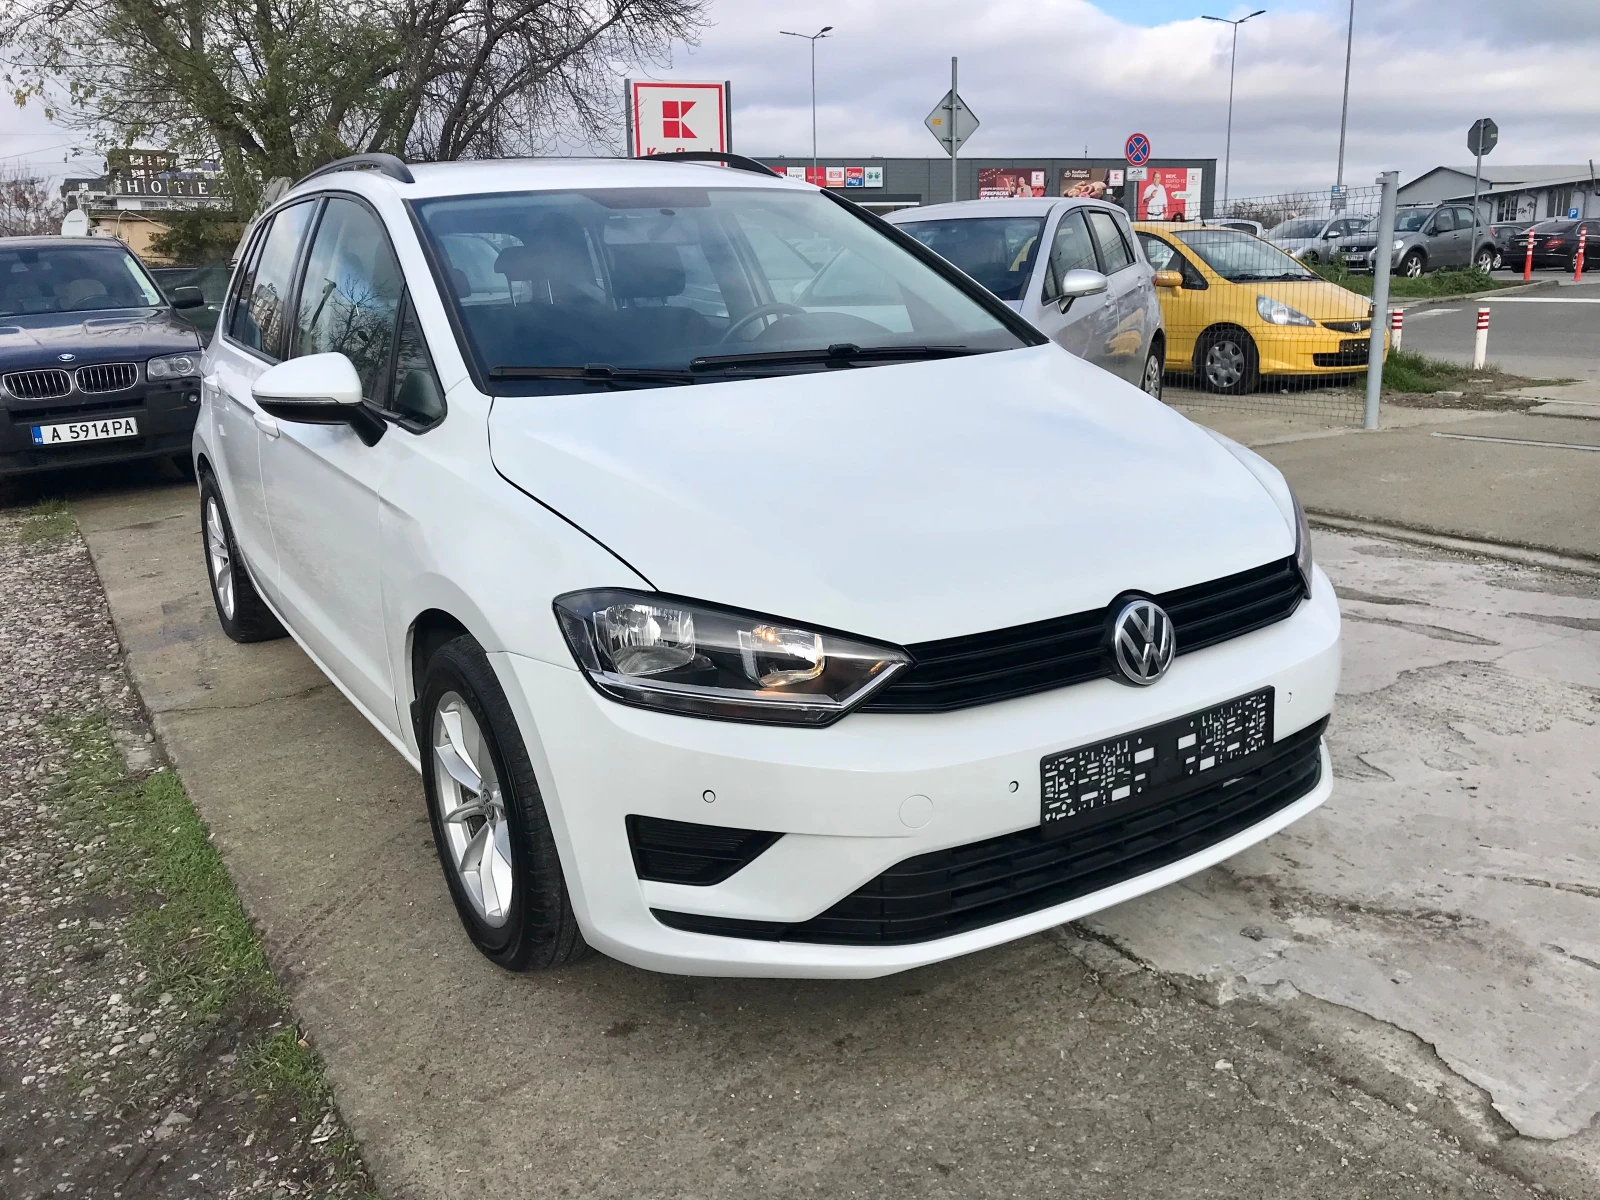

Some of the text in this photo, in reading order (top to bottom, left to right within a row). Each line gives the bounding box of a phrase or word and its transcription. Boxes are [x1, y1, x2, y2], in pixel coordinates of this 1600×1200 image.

[847, 171, 863, 180] Easy
[847, 178, 859, 186] Pay
[51, 419, 134, 441] A 5914PA
